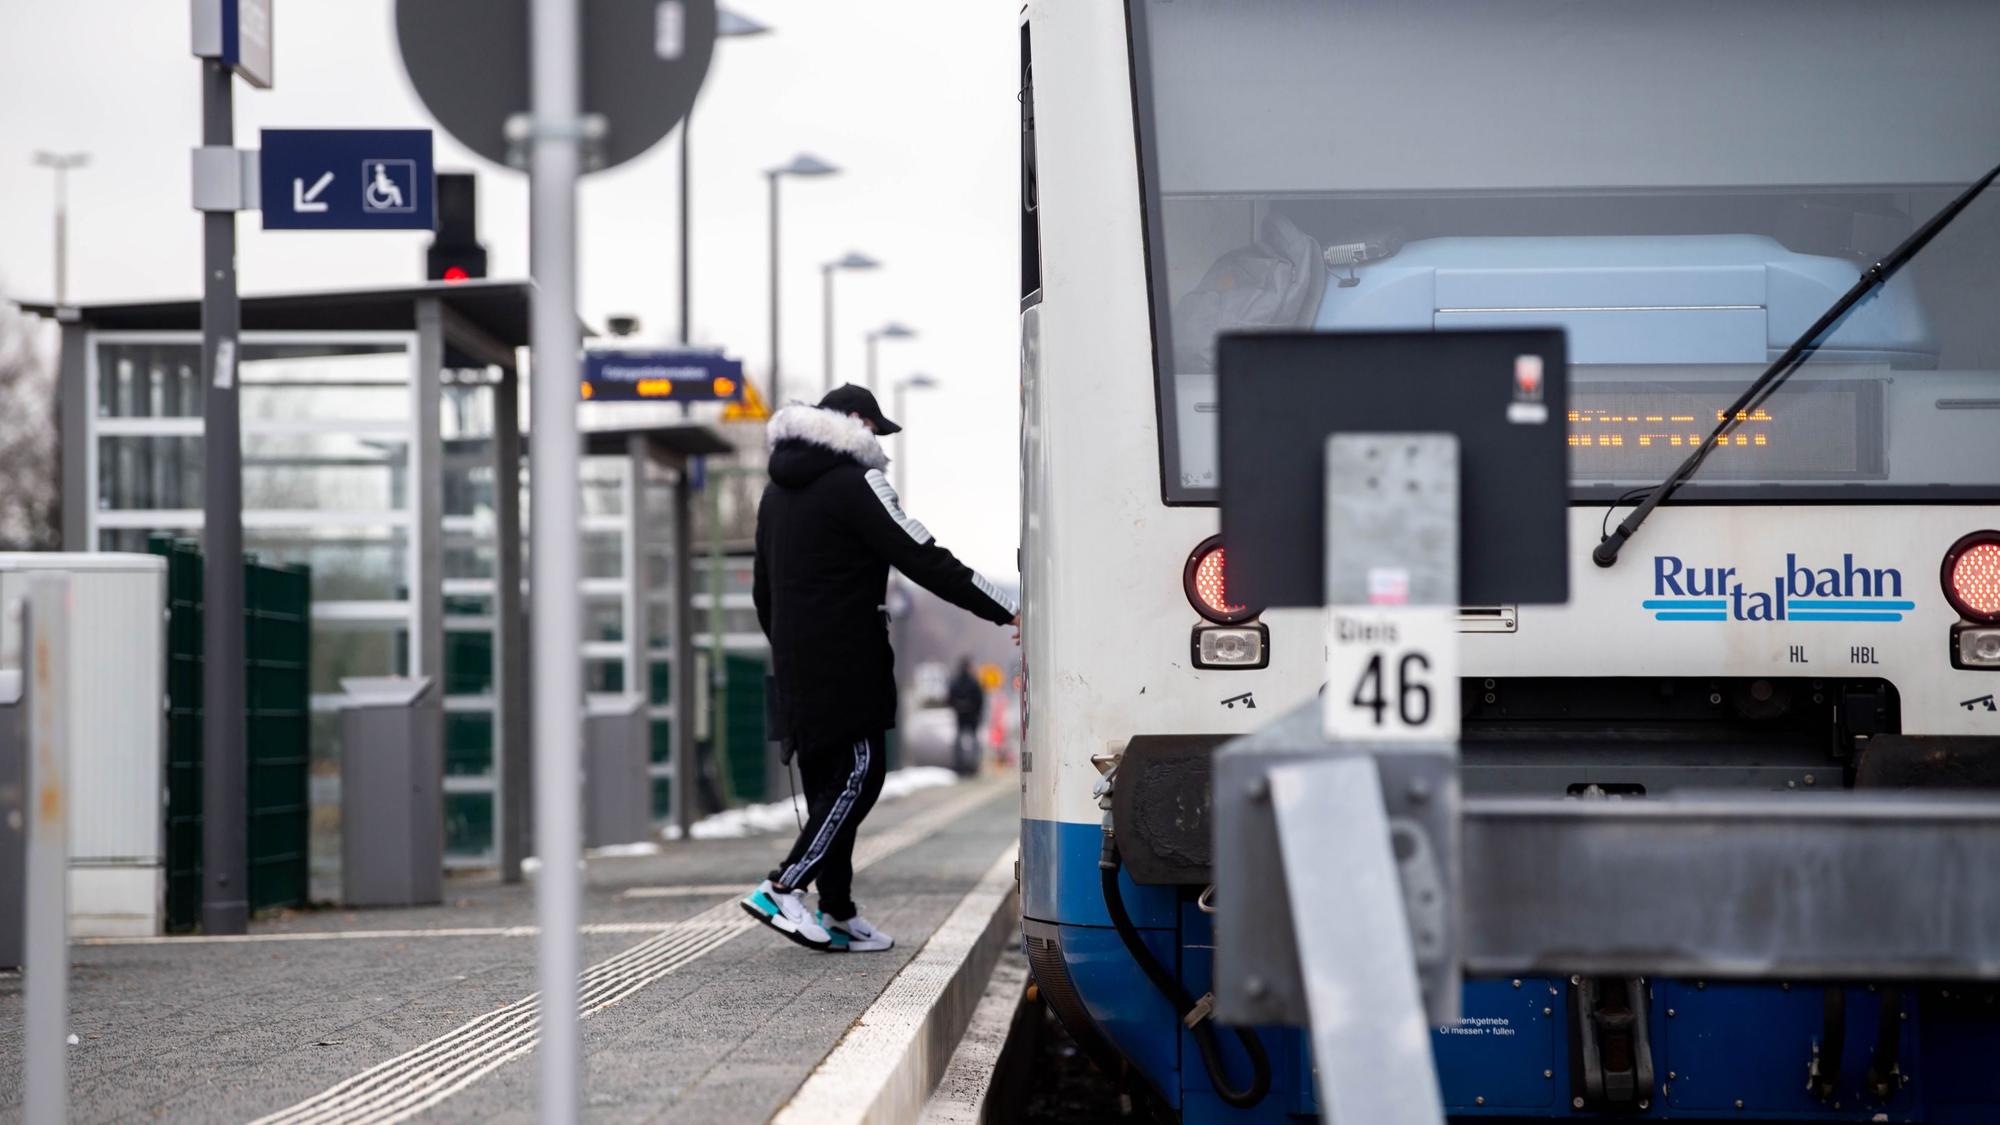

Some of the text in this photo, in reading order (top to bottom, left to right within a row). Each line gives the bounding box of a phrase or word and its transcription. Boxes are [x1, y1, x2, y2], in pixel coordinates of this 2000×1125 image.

[1789, 645, 1808, 663] HL
[1851, 646, 1879, 664] HBL
[1352, 653, 1431, 725] 46
[1451, 1027, 1483, 1035] messen
